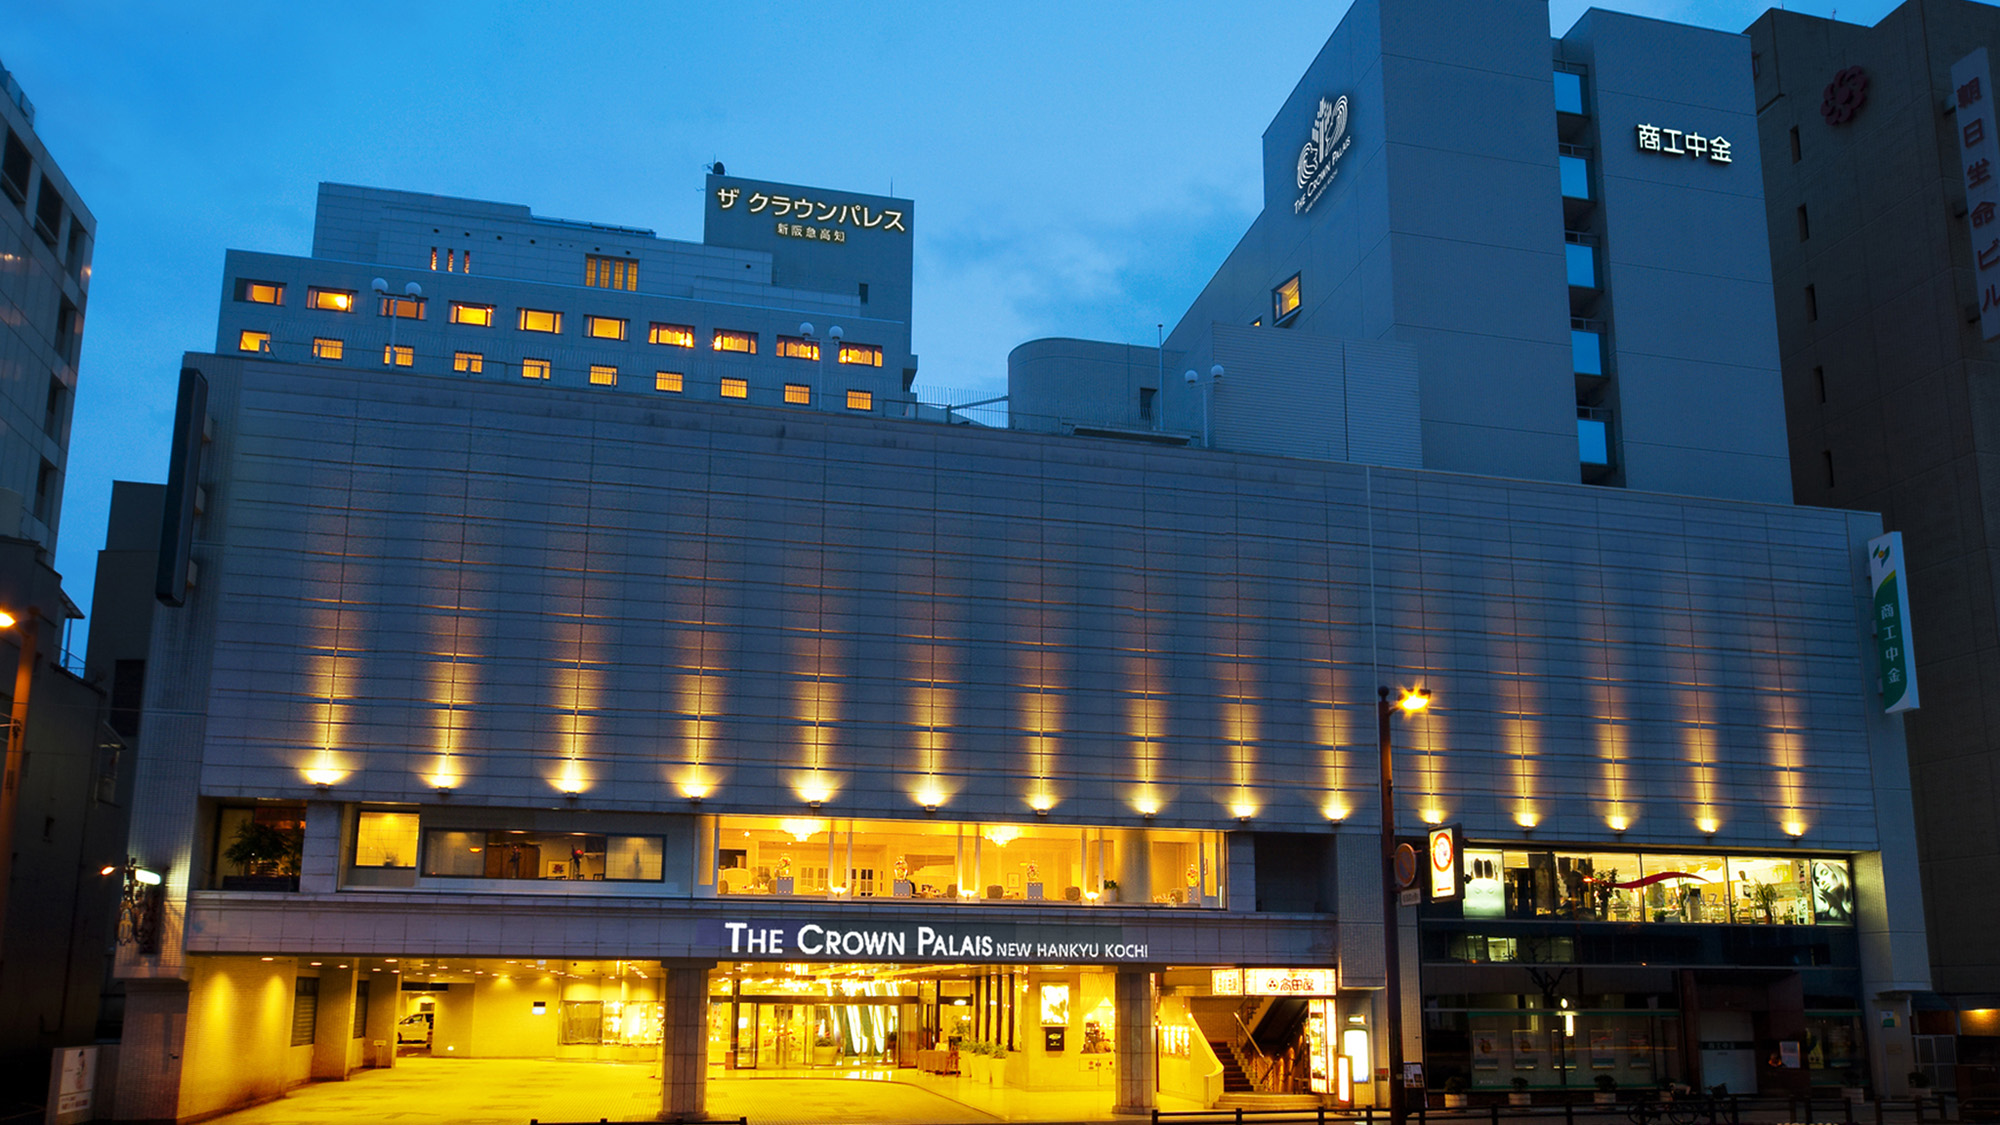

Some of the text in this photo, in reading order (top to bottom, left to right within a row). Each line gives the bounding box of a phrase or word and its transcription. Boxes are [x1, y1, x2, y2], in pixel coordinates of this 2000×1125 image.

[1638, 123, 1733, 163] 商工中金
[717, 188, 905, 232] ザ クラウンパレス
[777, 222, 846, 243] 新阪急高知
[1881, 603, 1901, 684] 商工中金
[725, 922, 1149, 958] THE CROWN PALAIS NEW HANKYU KOCHI
